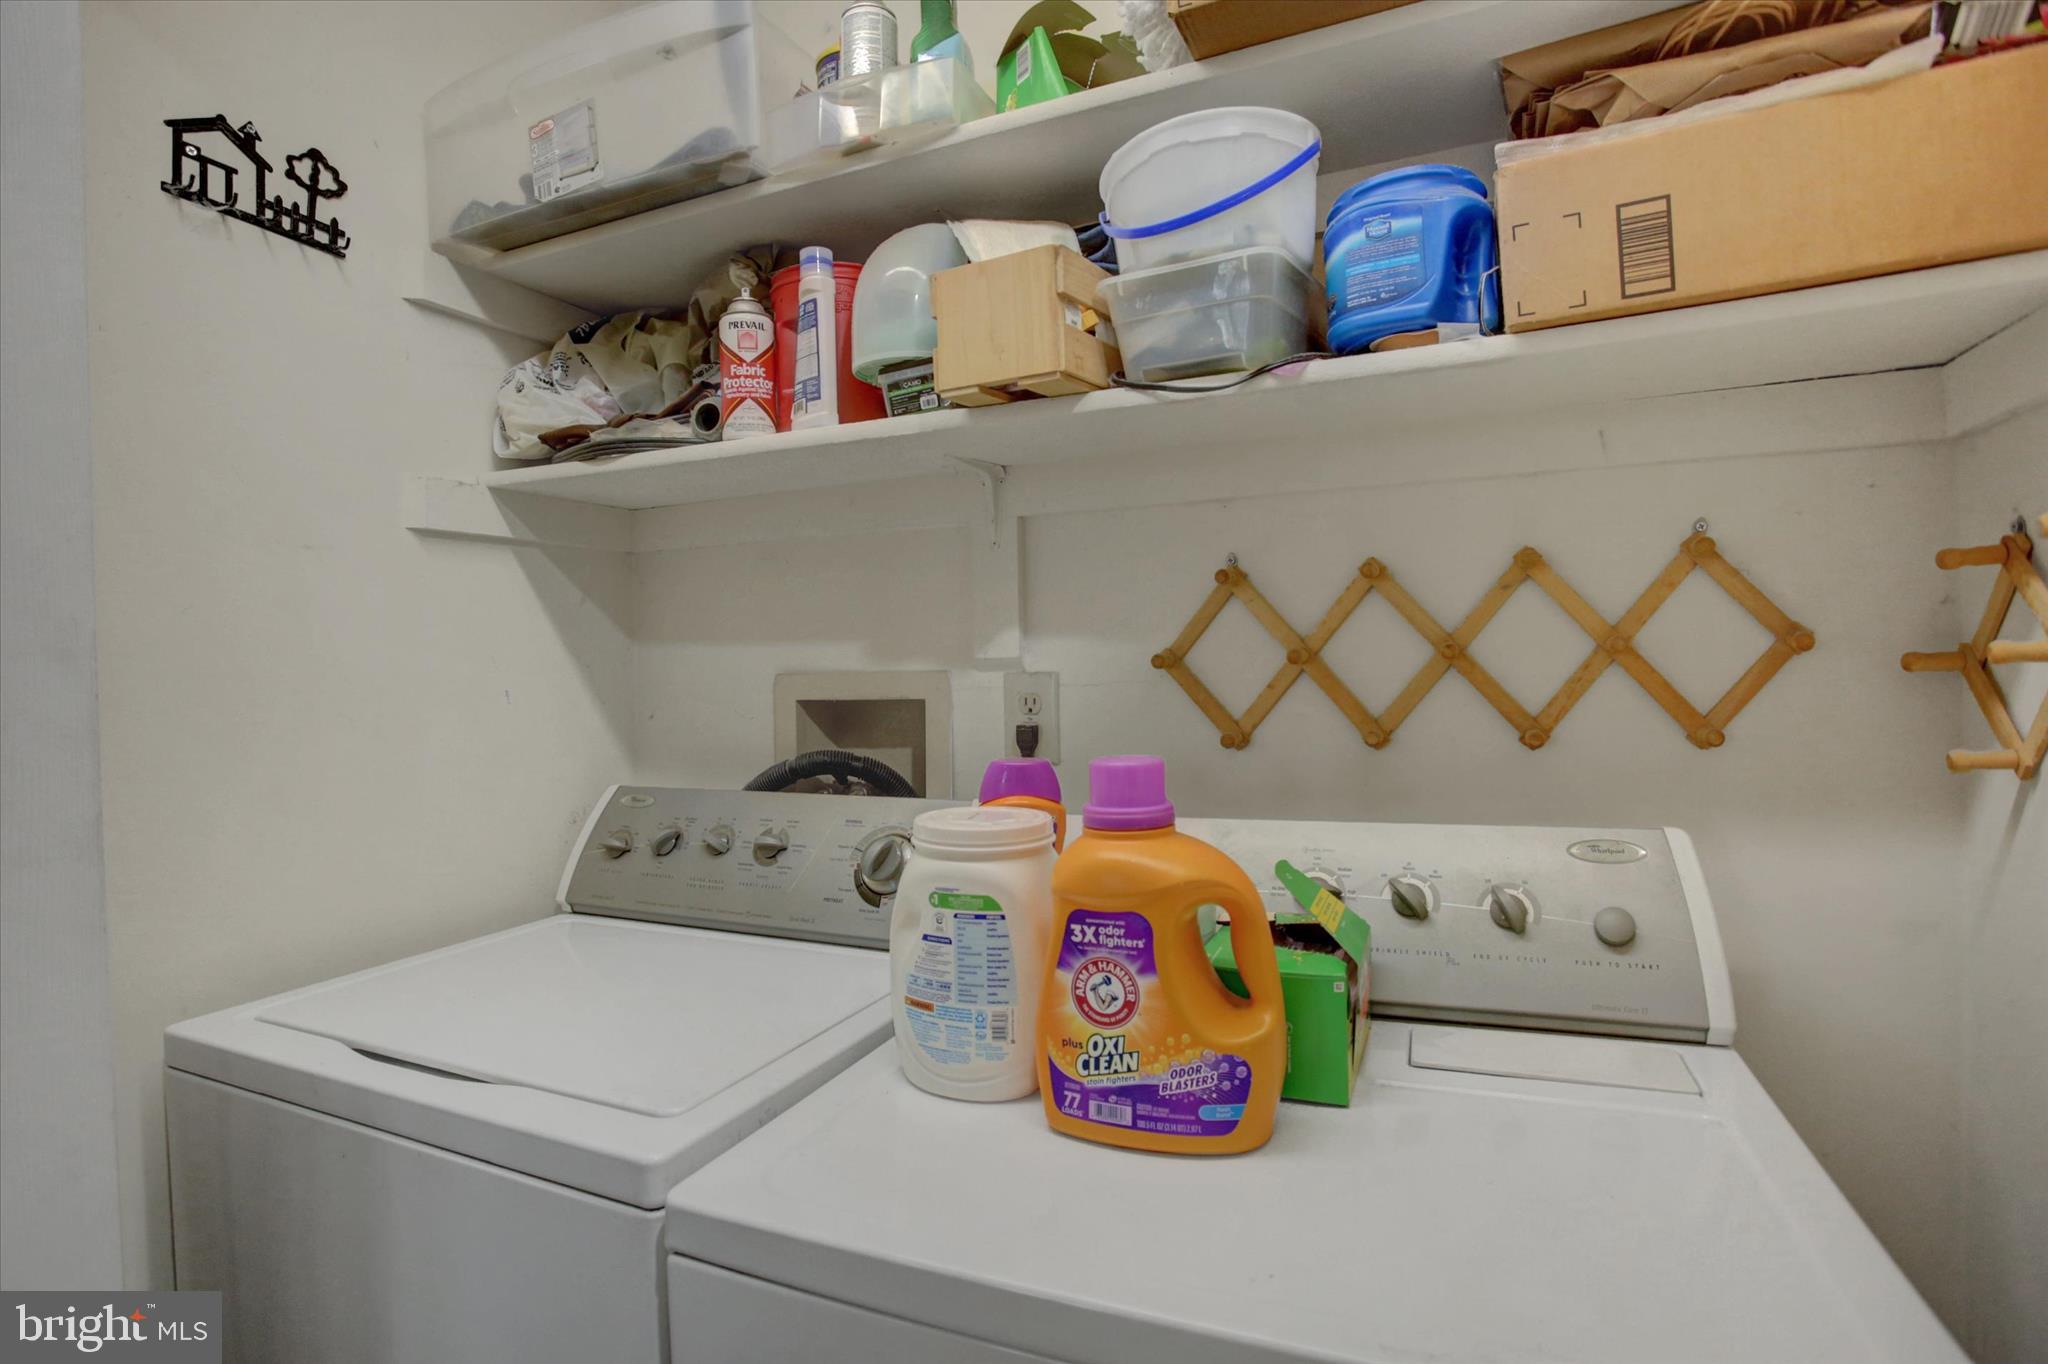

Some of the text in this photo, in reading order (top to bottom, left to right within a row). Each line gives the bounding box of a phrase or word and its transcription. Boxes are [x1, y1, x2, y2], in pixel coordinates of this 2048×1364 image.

[728, 321, 765, 331] PREVAIL
[730, 364, 766, 377] Fabric
[723, 376, 774, 391] Protector
[1070, 924, 1125, 943] 3X odor
[1075, 961, 1136, 1002] ARM & HAMMER
[1062, 1037, 1084, 1049] plus
[1086, 1033, 1125, 1058] OXI
[1076, 1051, 1139, 1077] CLEAN
[1170, 1064, 1203, 1080] ODOR
[1087, 1077, 1104, 1086] stain
[1105, 1076, 1137, 1085] fighters
[1161, 1072, 1217, 1093] BLASTERS
[1063, 1090, 1081, 1108] 77
